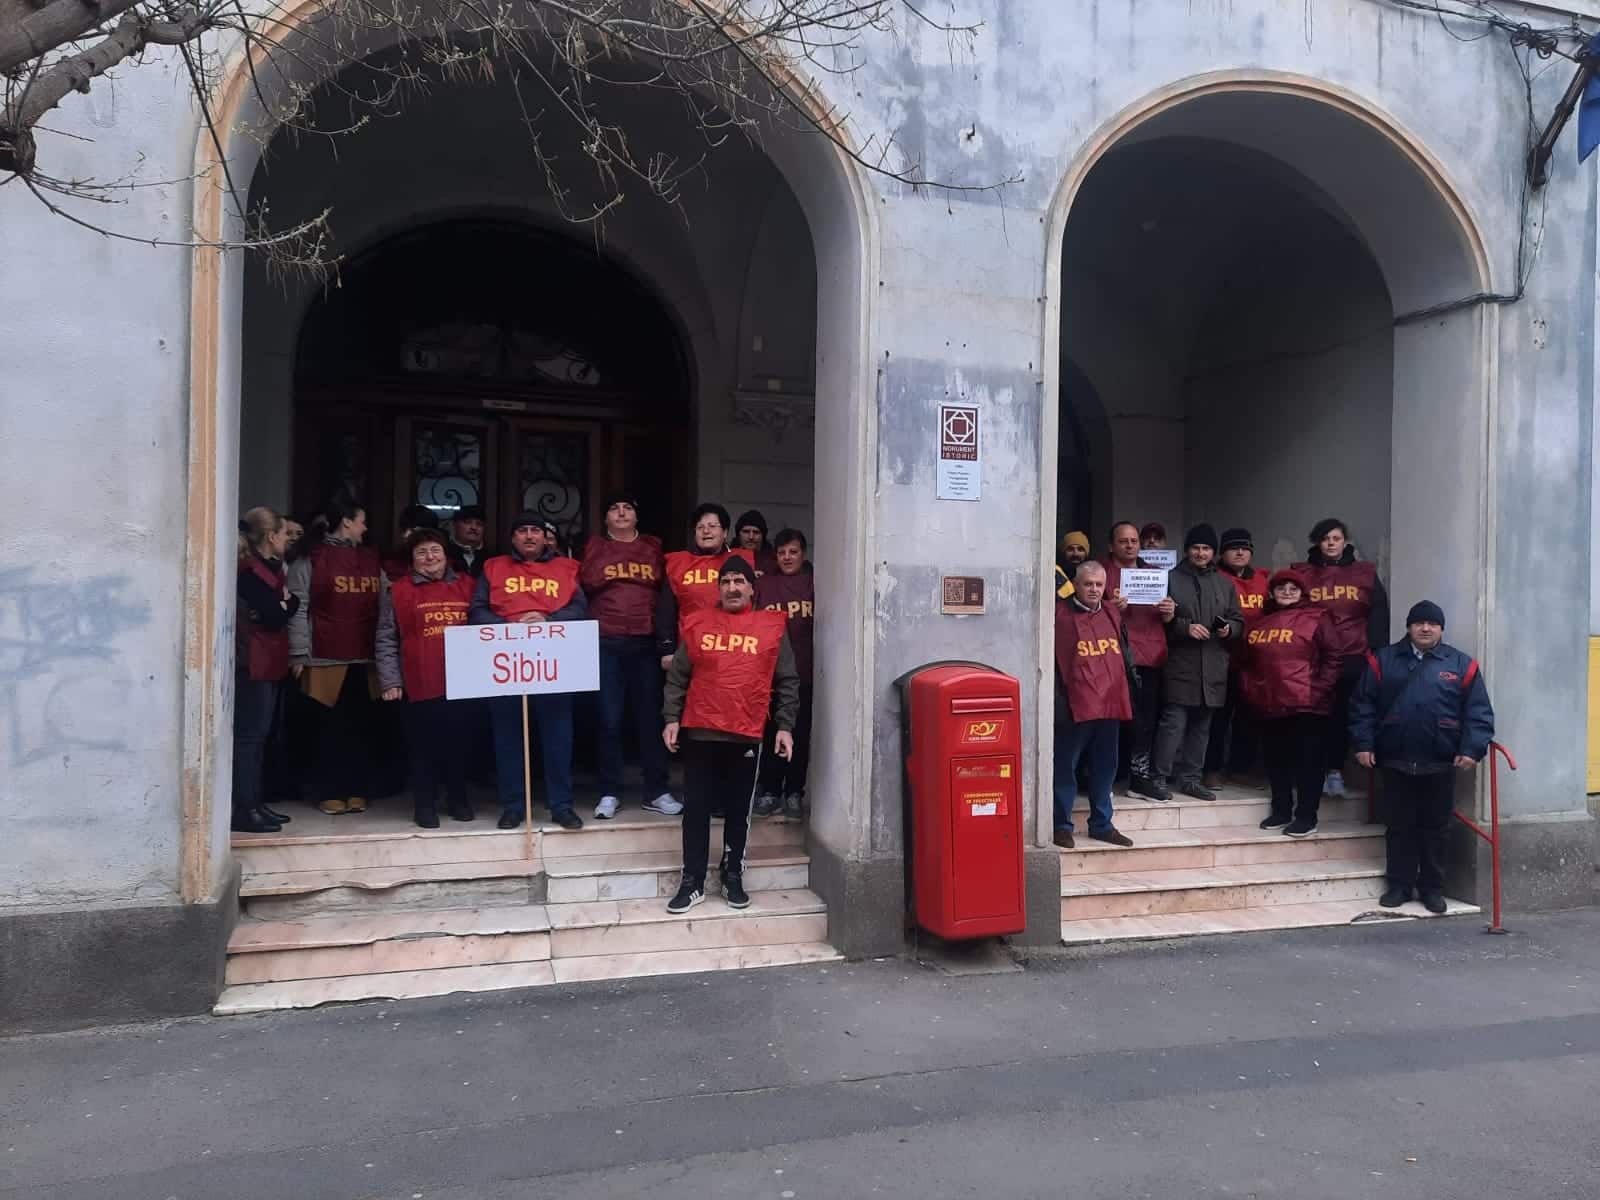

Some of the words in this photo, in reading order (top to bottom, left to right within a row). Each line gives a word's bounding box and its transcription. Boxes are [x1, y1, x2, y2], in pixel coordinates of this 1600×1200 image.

[604, 563, 655, 581] SLPR
[682, 568, 720, 585] SLP
[335, 575, 380, 593] SLPR
[505, 576, 559, 598] SLPR
[1239, 593, 1264, 609] LPR
[1310, 585, 1360, 602] SLPR
[479, 624, 566, 641] S.L.P.R
[1248, 628, 1293, 644] SLPR
[701, 633, 759, 655] SLPR
[1077, 638, 1121, 657] SLPR
[492, 652, 558, 684] Sibiu
